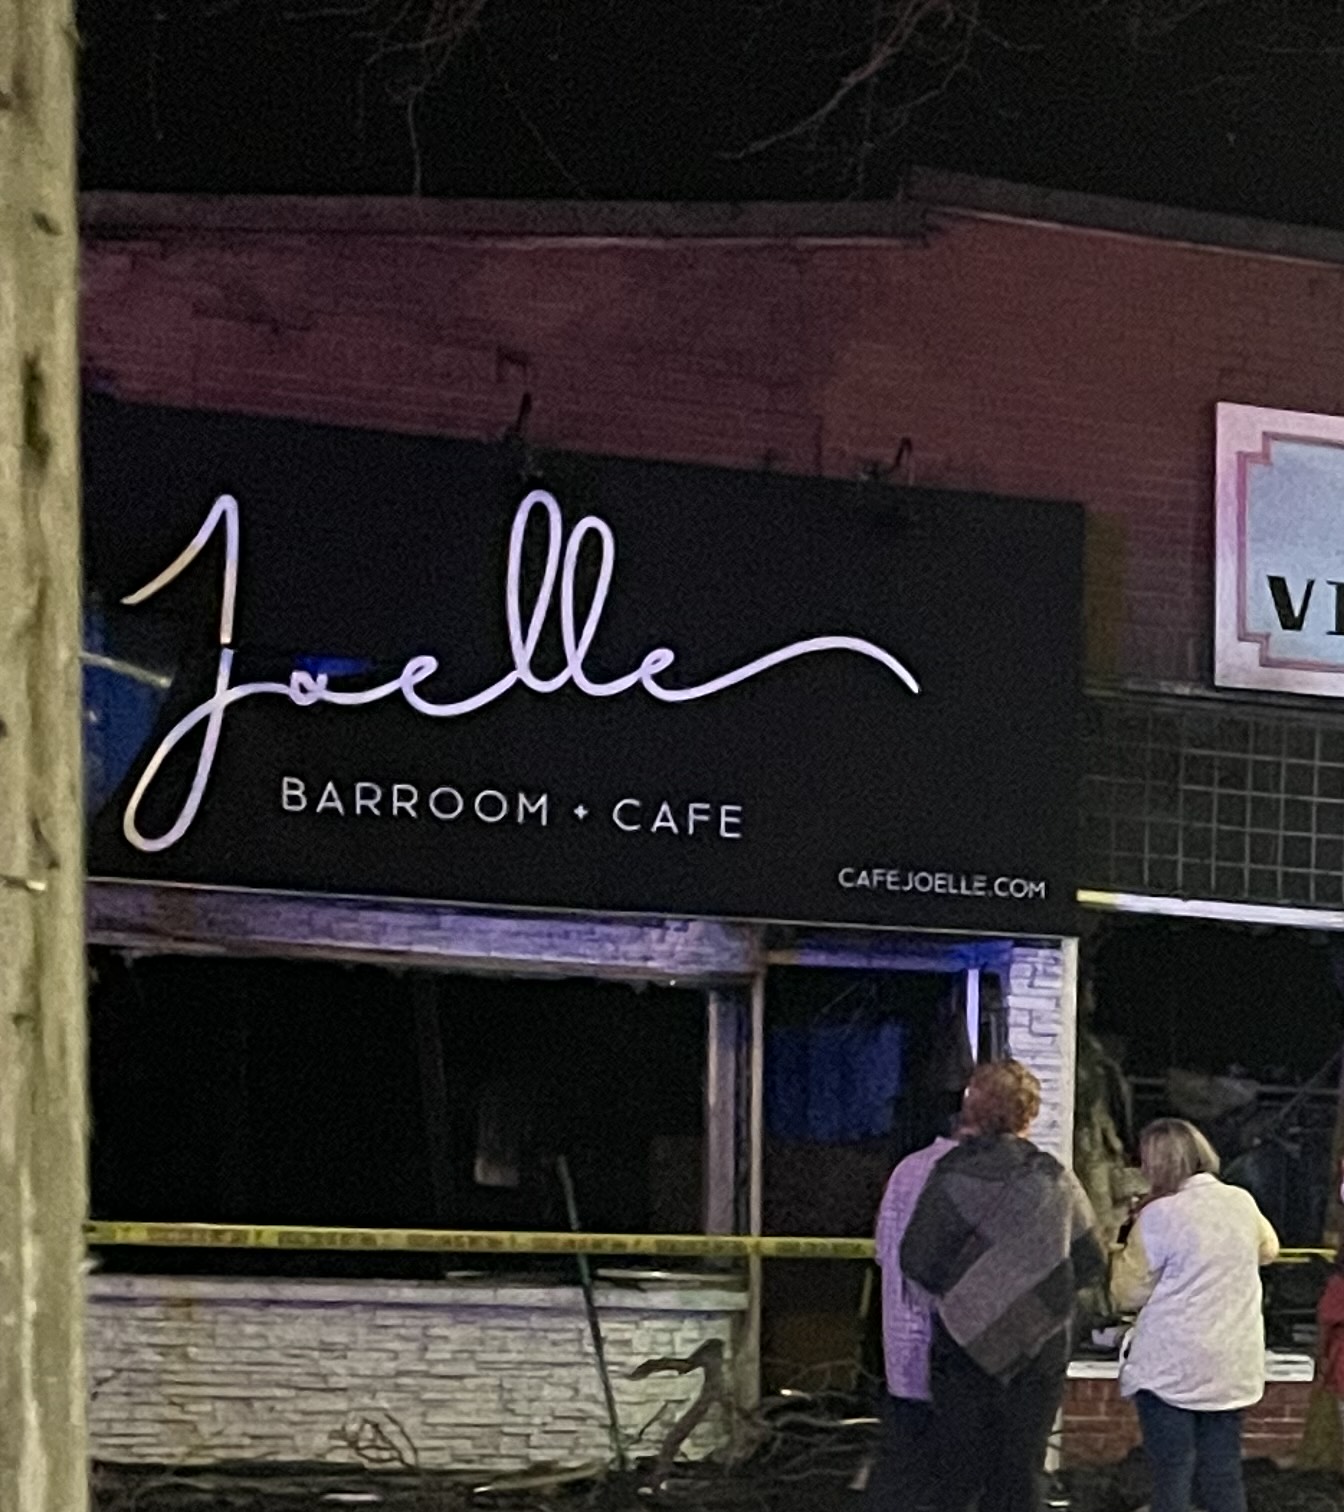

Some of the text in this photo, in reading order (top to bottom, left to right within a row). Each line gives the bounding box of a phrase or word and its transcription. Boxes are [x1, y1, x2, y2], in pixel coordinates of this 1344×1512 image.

[122, 489, 920, 852] Joelle
[282, 776, 549, 826] BARROOM
[612, 798, 743, 838] CAFE
[838, 867, 1047, 899] CAFEJOELLE.COM
